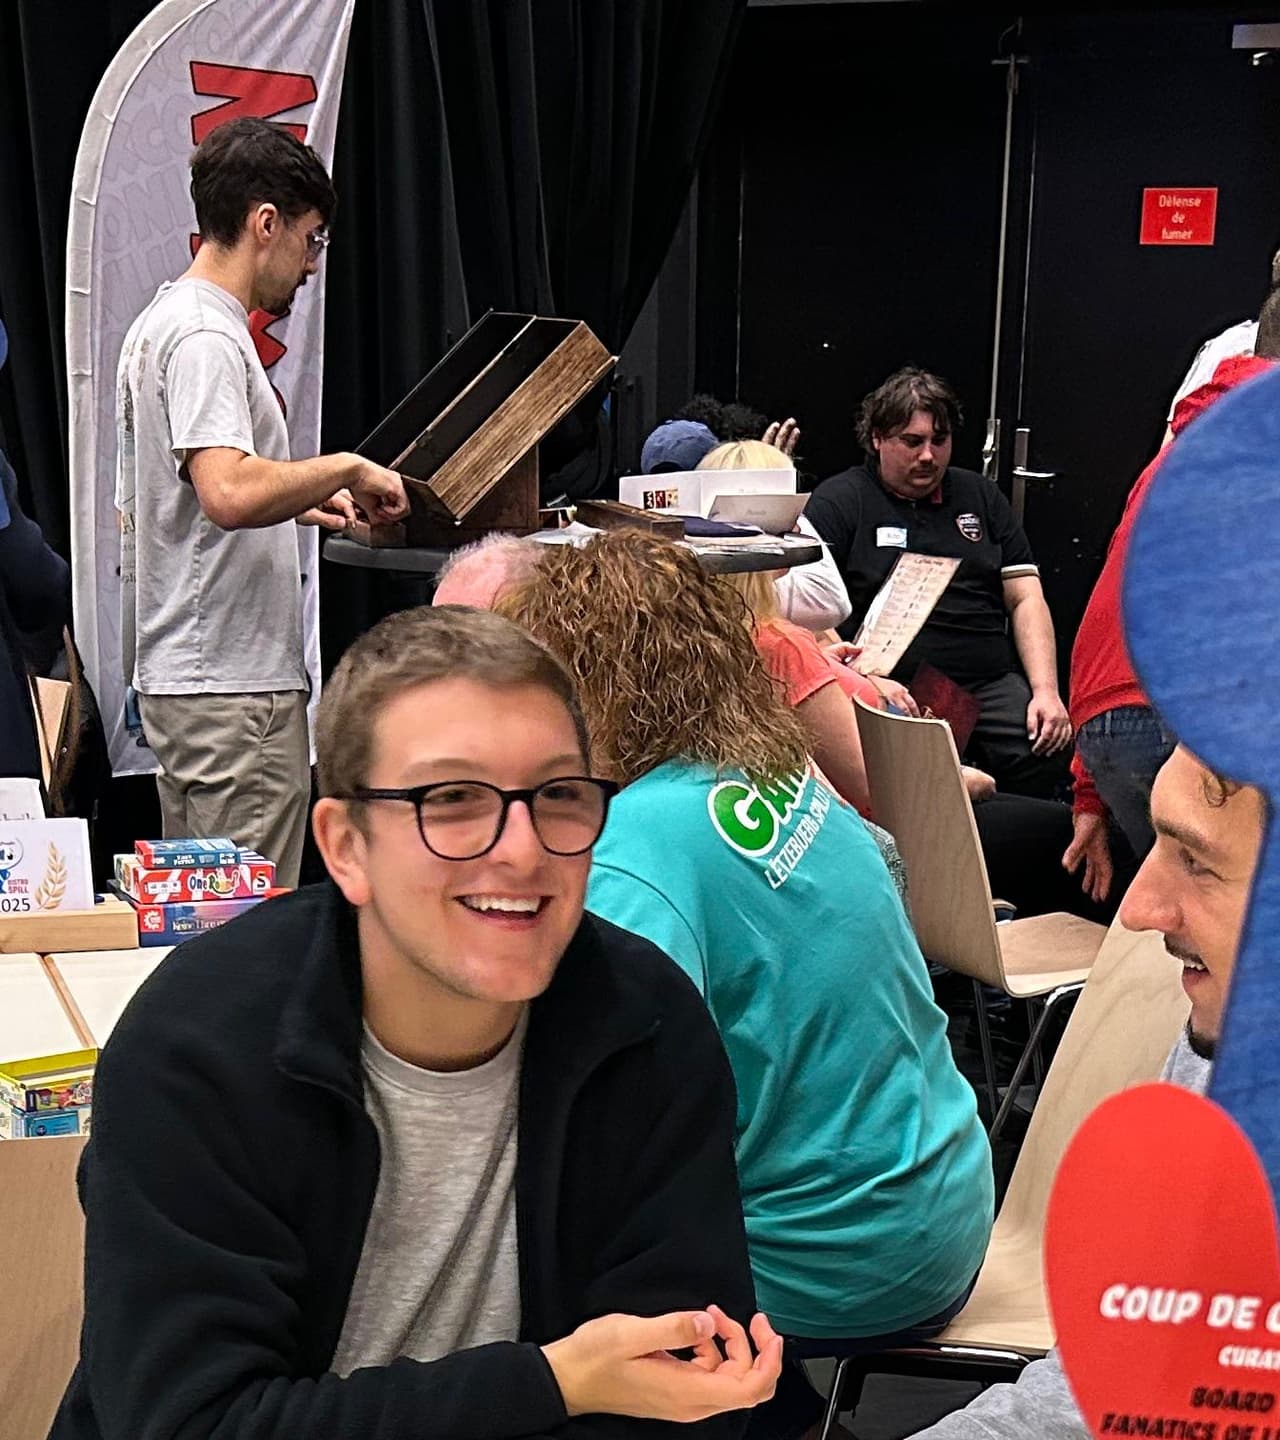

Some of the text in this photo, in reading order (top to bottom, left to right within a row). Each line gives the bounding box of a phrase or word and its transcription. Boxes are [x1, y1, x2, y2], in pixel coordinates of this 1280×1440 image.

[1171, 211, 1186, 223] de
[189, 876, 207, 891] One
[1100, 1286, 1200, 1325] COUP
[1207, 1297, 1256, 1330] DE
[1189, 1387, 1275, 1414] BOARD
